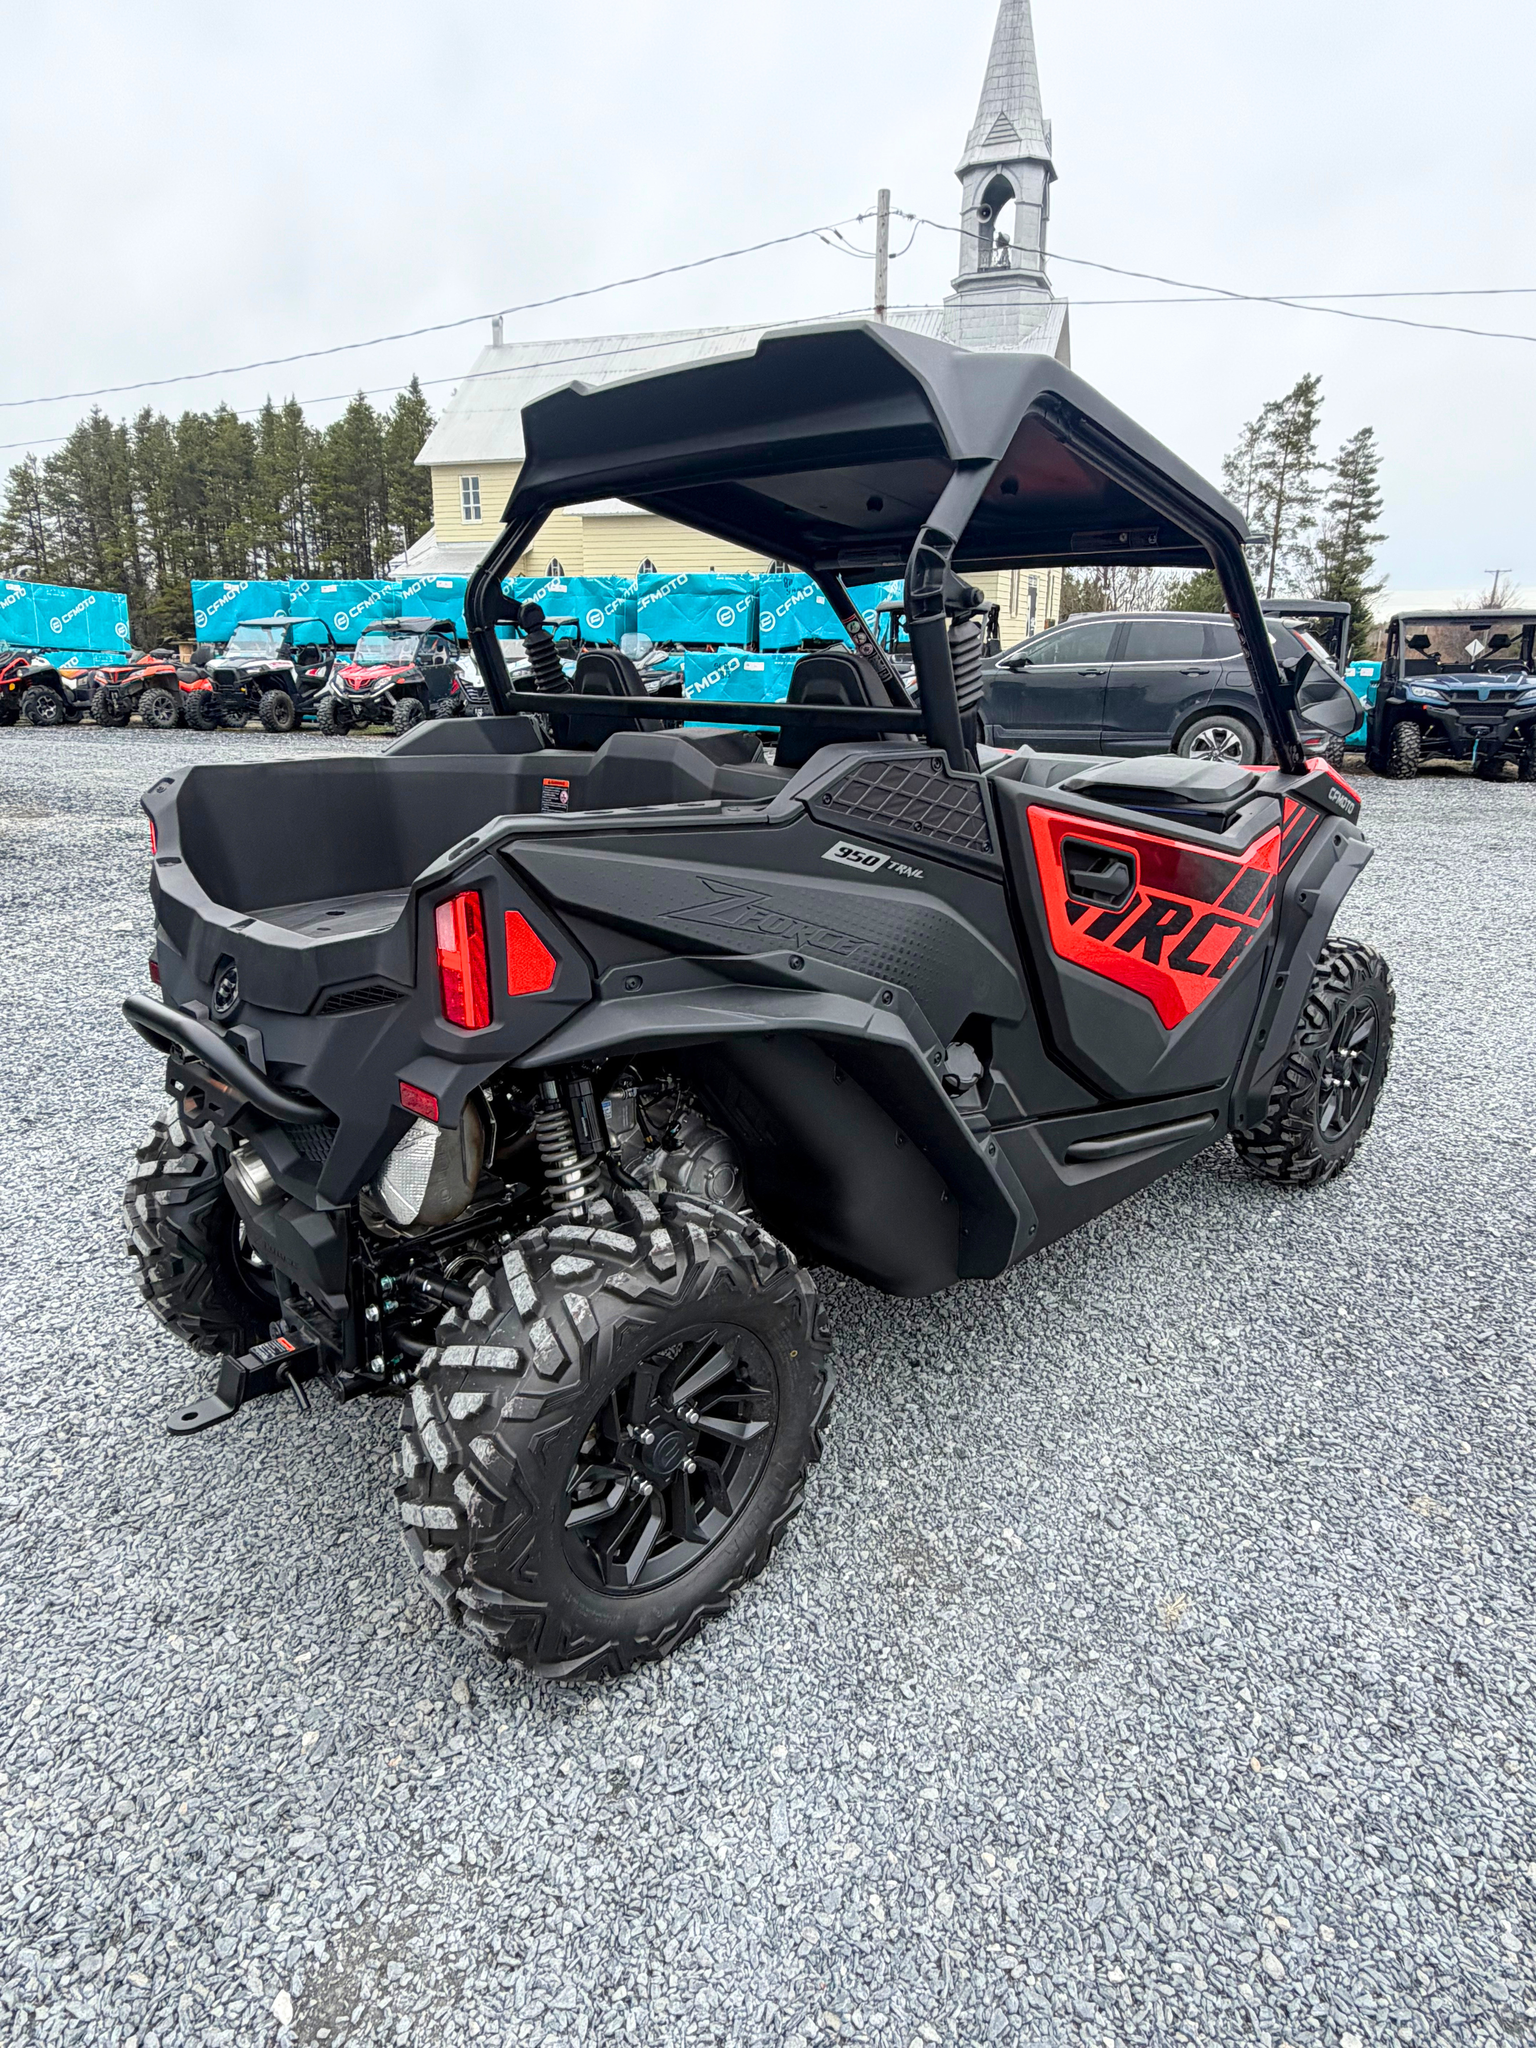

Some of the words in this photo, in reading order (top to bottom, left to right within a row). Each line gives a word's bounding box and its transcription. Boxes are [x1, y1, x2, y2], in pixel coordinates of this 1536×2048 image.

[0, 588, 27, 609] MOTO
[206, 580, 249, 616] CFMOTO
[521, 578, 560, 604] MOTO
[61, 595, 96, 624] CFMOTO
[1327, 786, 1356, 815] CFMOTO
[834, 846, 881, 867] 950
[887, 860, 925, 879] TRAIL
